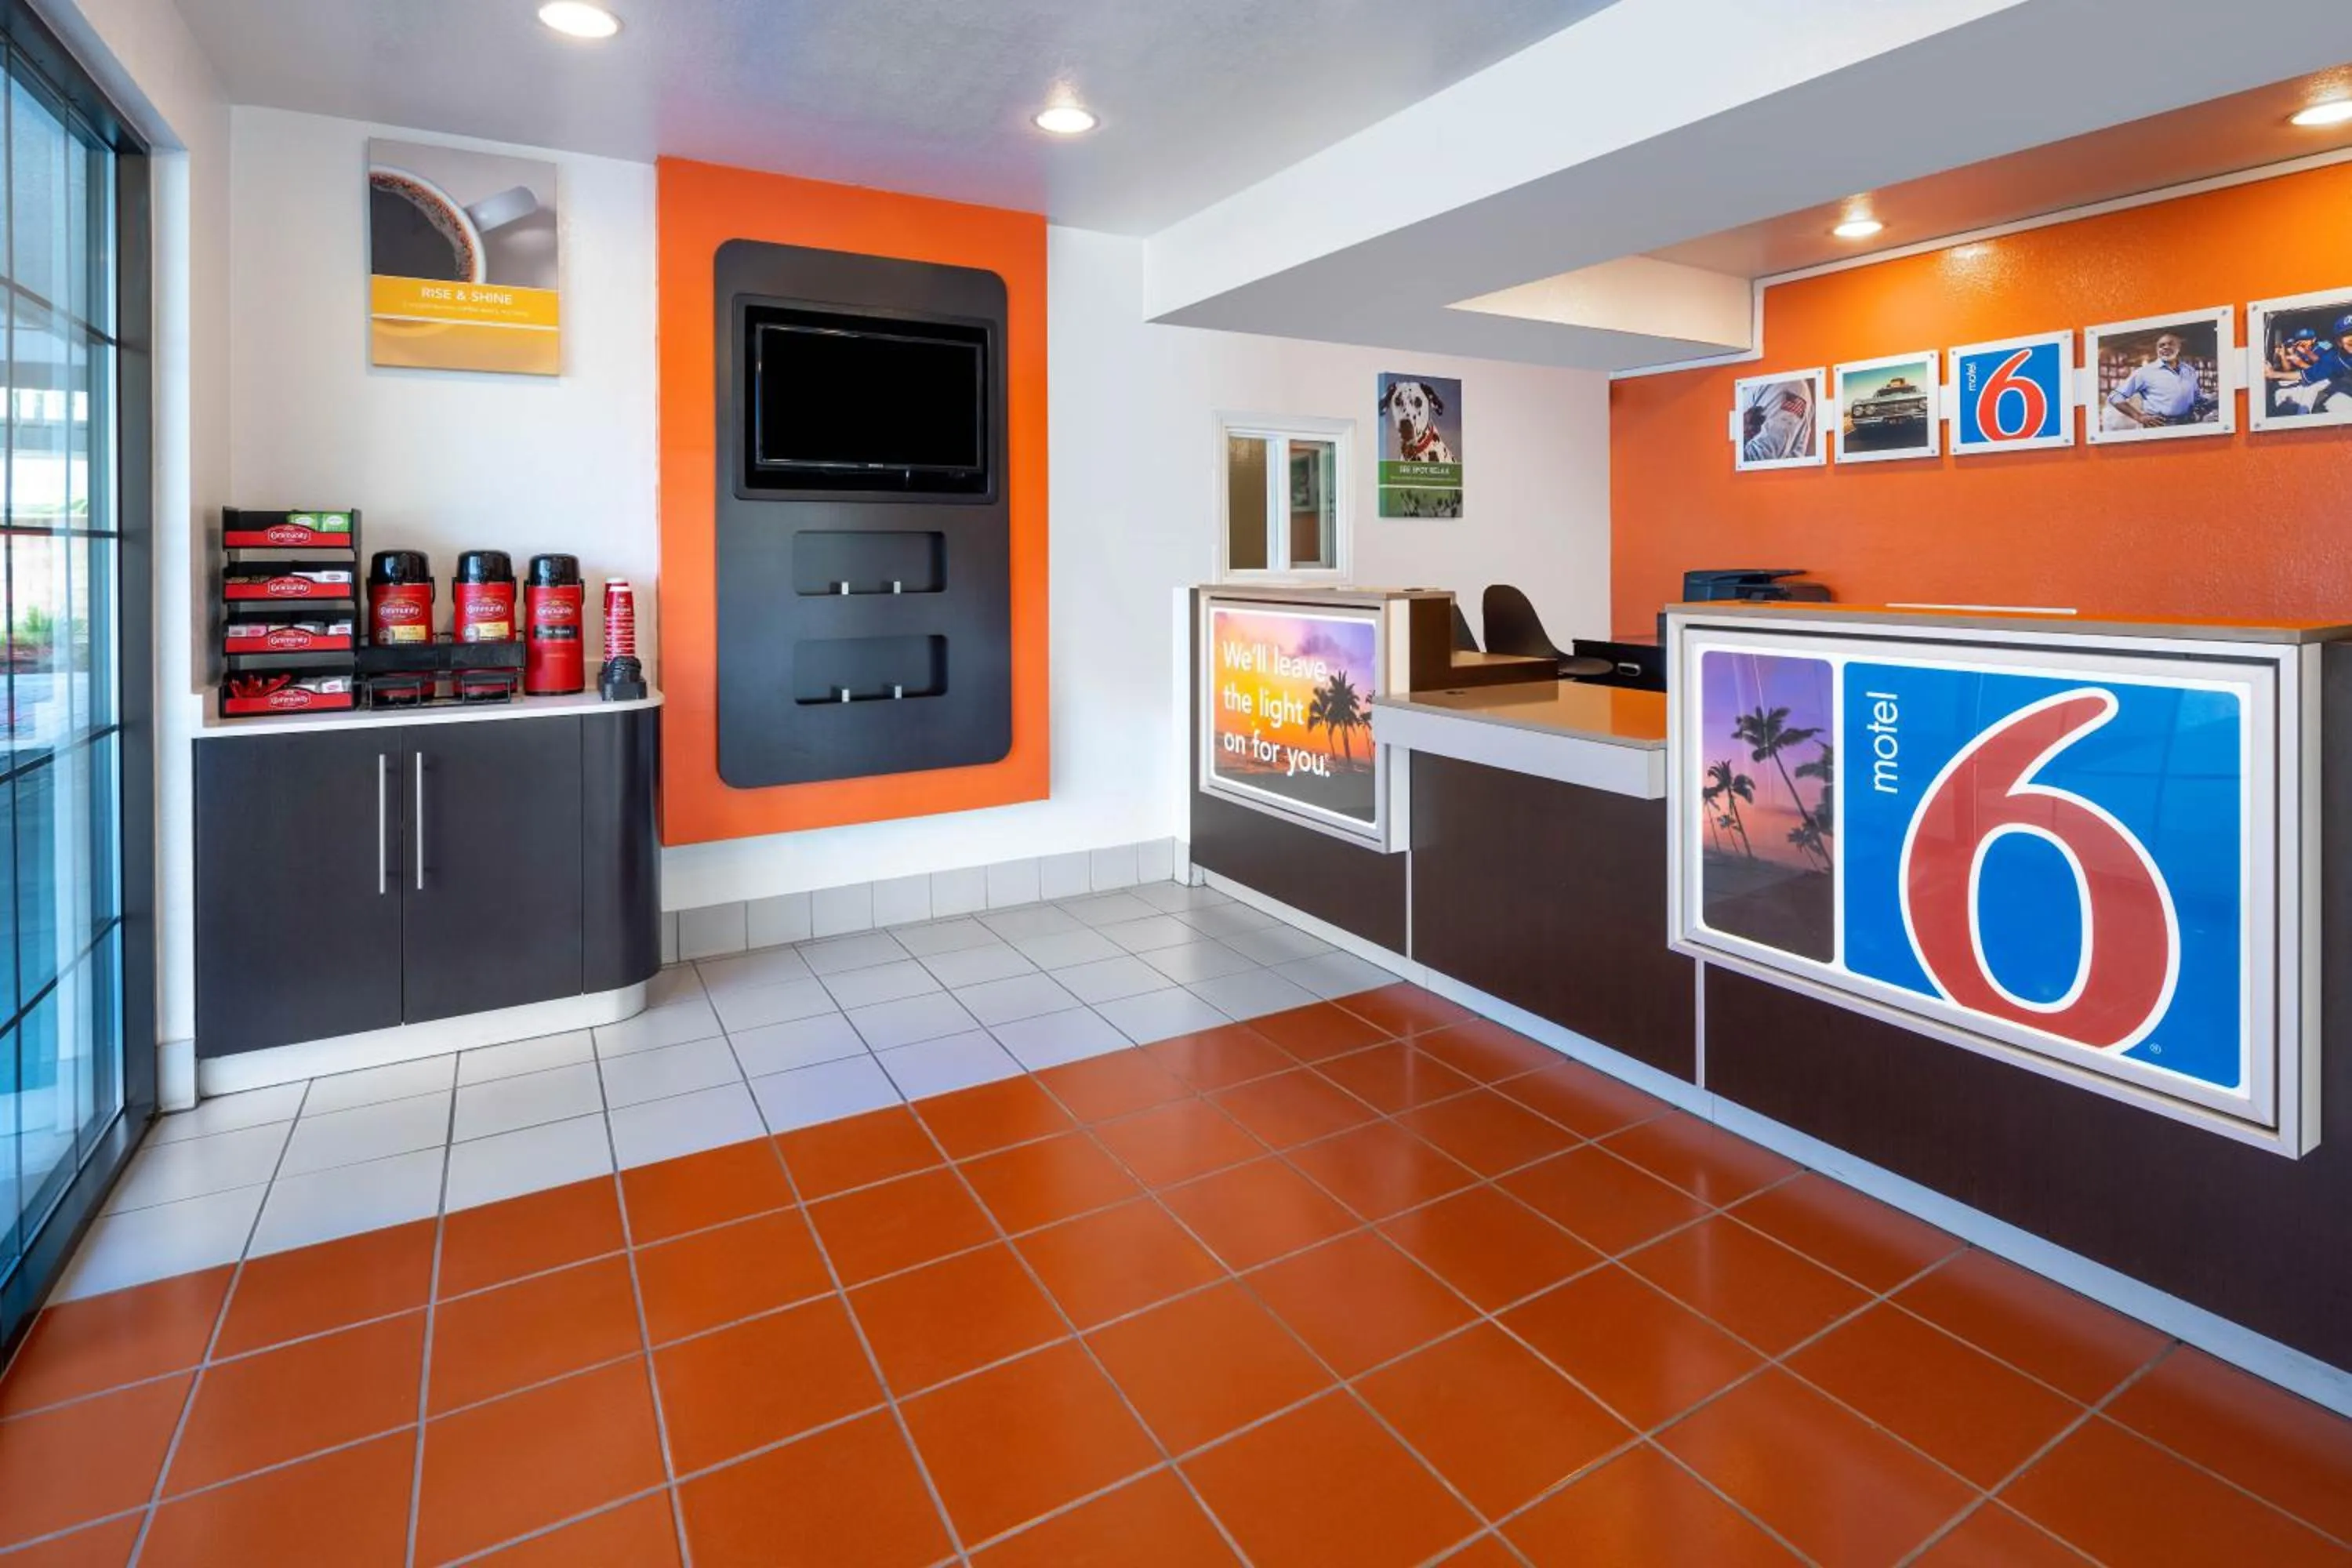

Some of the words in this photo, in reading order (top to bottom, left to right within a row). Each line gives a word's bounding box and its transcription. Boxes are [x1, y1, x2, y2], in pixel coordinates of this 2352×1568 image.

[421, 288, 452, 300] RISE
[456, 291, 466, 302] &
[471, 292, 513, 306] SHINE
[1965, 361, 1976, 392] motel
[1976, 348, 2048, 442] 6
[1222, 641, 1268, 673] We'll
[1274, 646, 1327, 682] leave
[1223, 682, 1253, 714] the
[1259, 688, 1304, 728] light
[1224, 731, 1246, 755] on
[1251, 729, 1279, 764] for
[1866, 691, 1898, 794] motel
[1899, 687, 2181, 1056] 6
